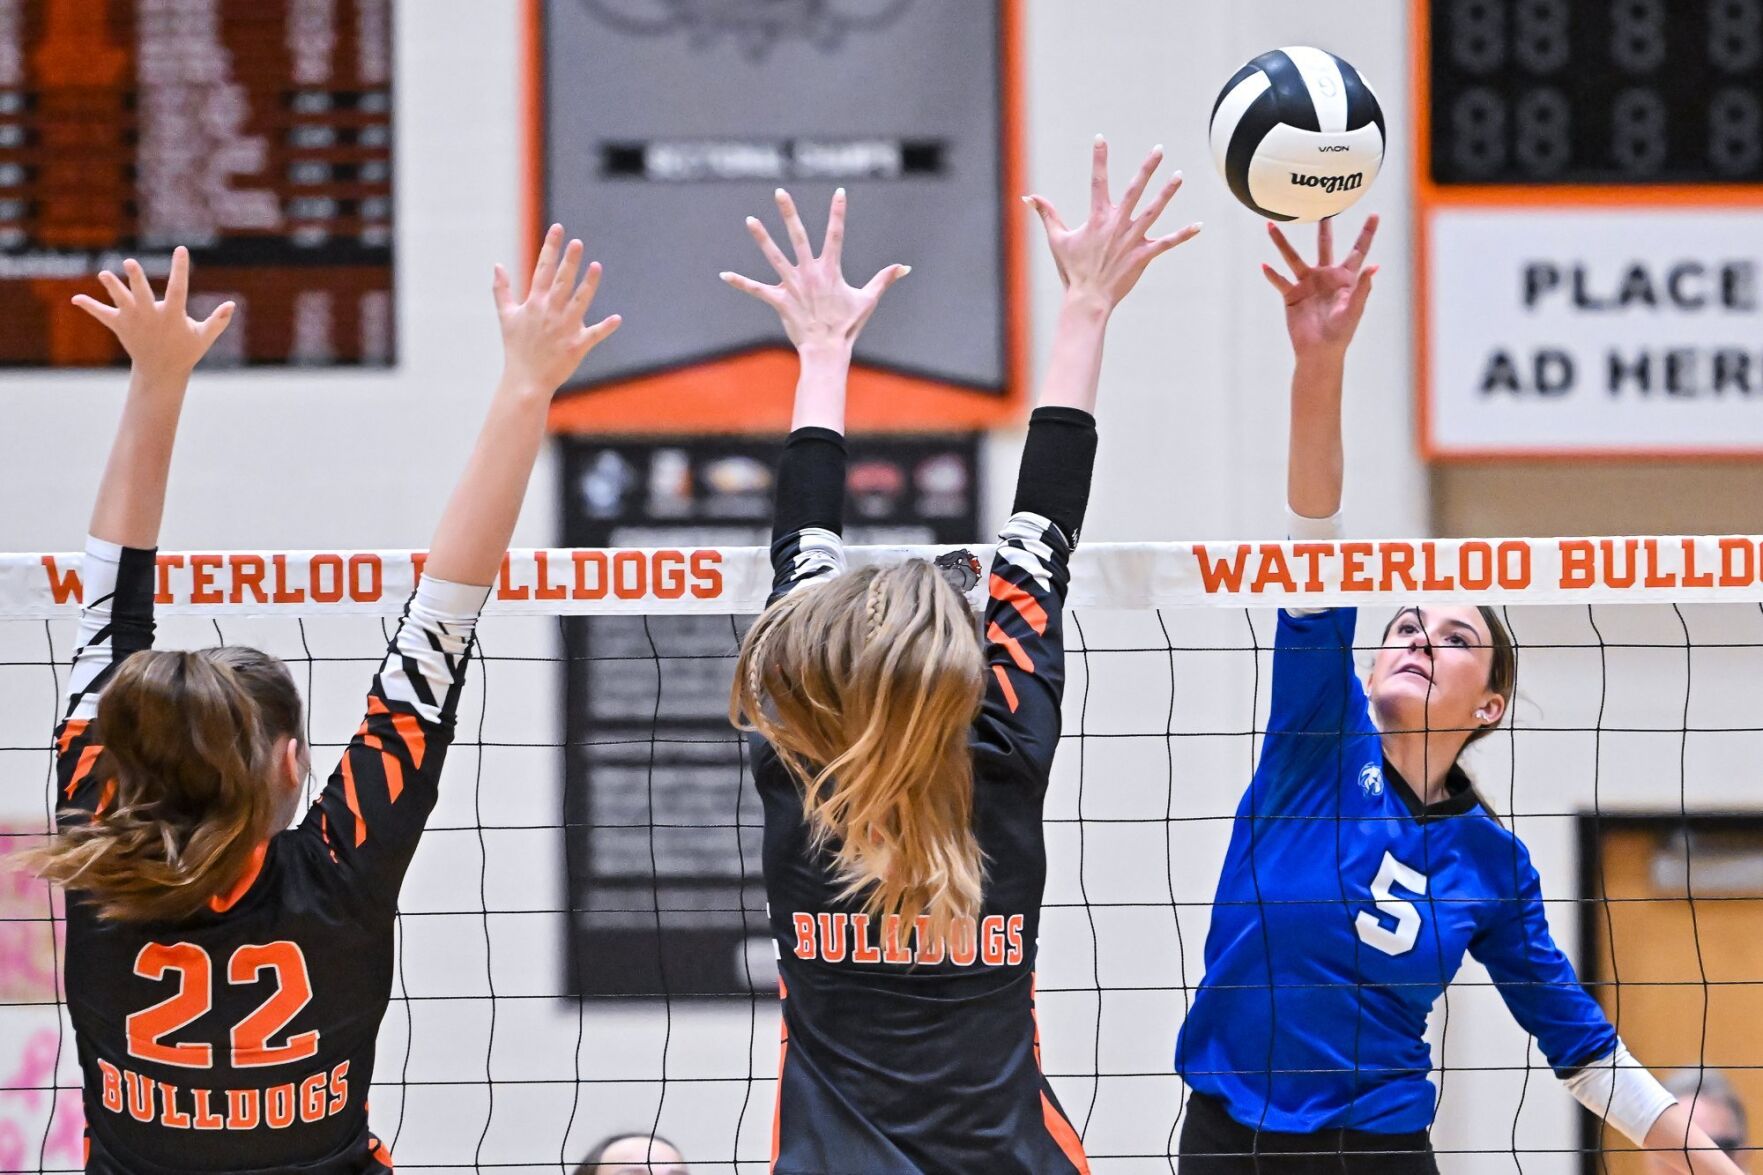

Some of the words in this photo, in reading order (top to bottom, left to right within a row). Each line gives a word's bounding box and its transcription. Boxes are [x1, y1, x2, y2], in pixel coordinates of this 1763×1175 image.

[1290, 172, 1363, 193] Wilson
[1523, 261, 1757, 311] PLACE
[1480, 348, 1575, 397] AD
[1607, 348, 1763, 397] HER
[41, 554, 382, 604] WTERLOO
[411, 550, 722, 600] LLDOGS
[1192, 541, 1530, 593] WATERLOO
[1559, 538, 1763, 589] BULLD
[1355, 850, 1427, 956] 5
[793, 912, 1024, 966] BULLDOGS
[126, 941, 320, 1068] 22
[97, 1058, 350, 1130] BULLDOGS
